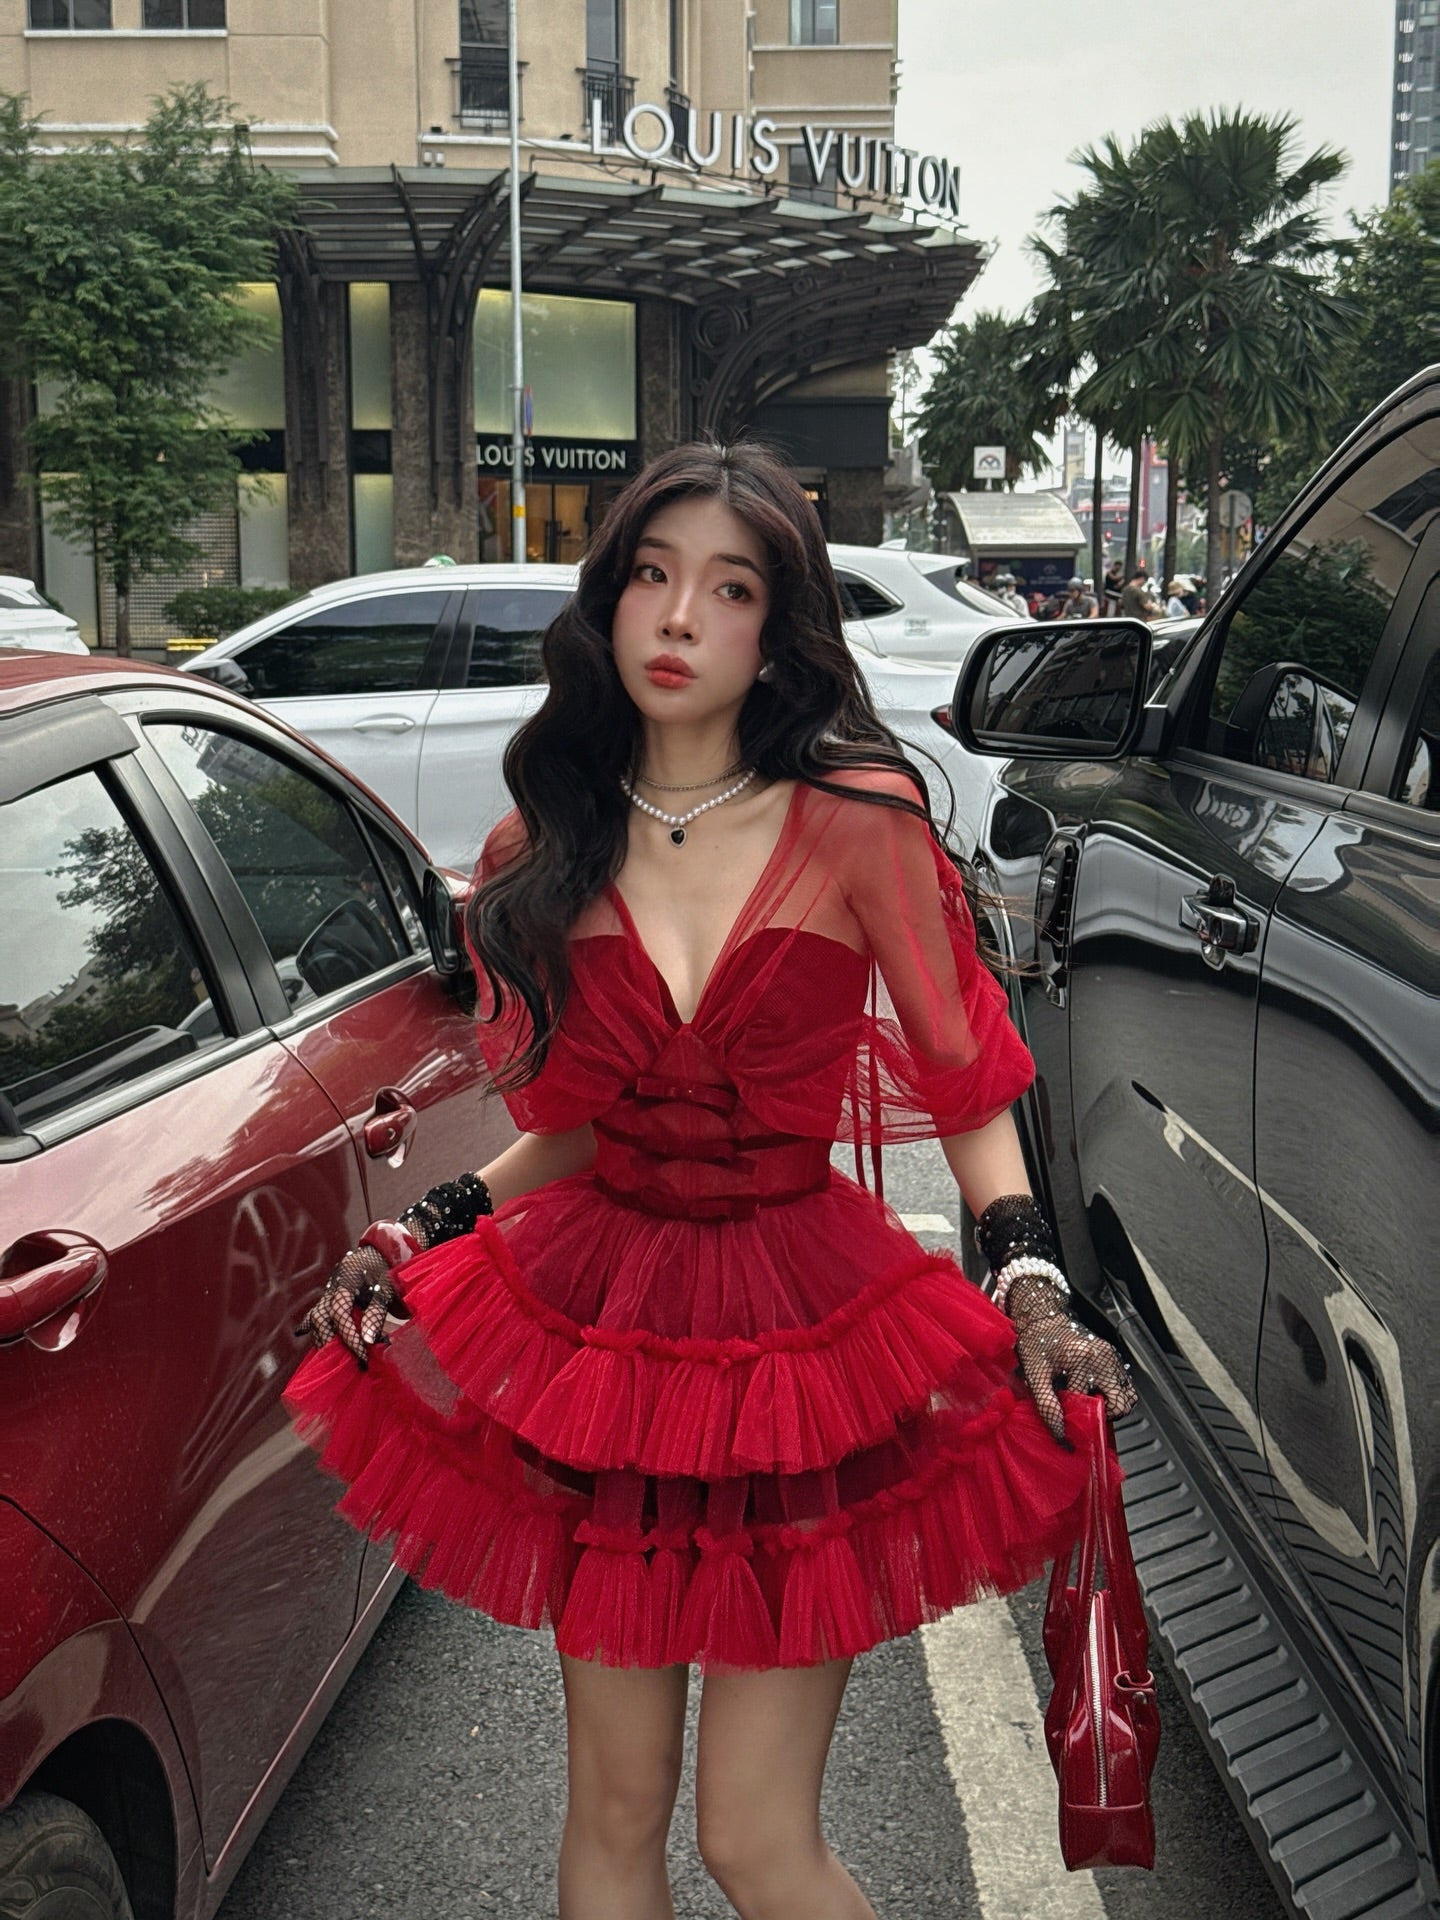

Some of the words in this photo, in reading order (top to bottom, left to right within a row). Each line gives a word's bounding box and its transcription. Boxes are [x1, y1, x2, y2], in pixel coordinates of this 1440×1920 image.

[590, 98, 781, 175] LOUIS
[801, 123, 961, 216] VUITTON
[476, 444, 535, 467] LOUS
[541, 447, 627, 469] VUITTON
